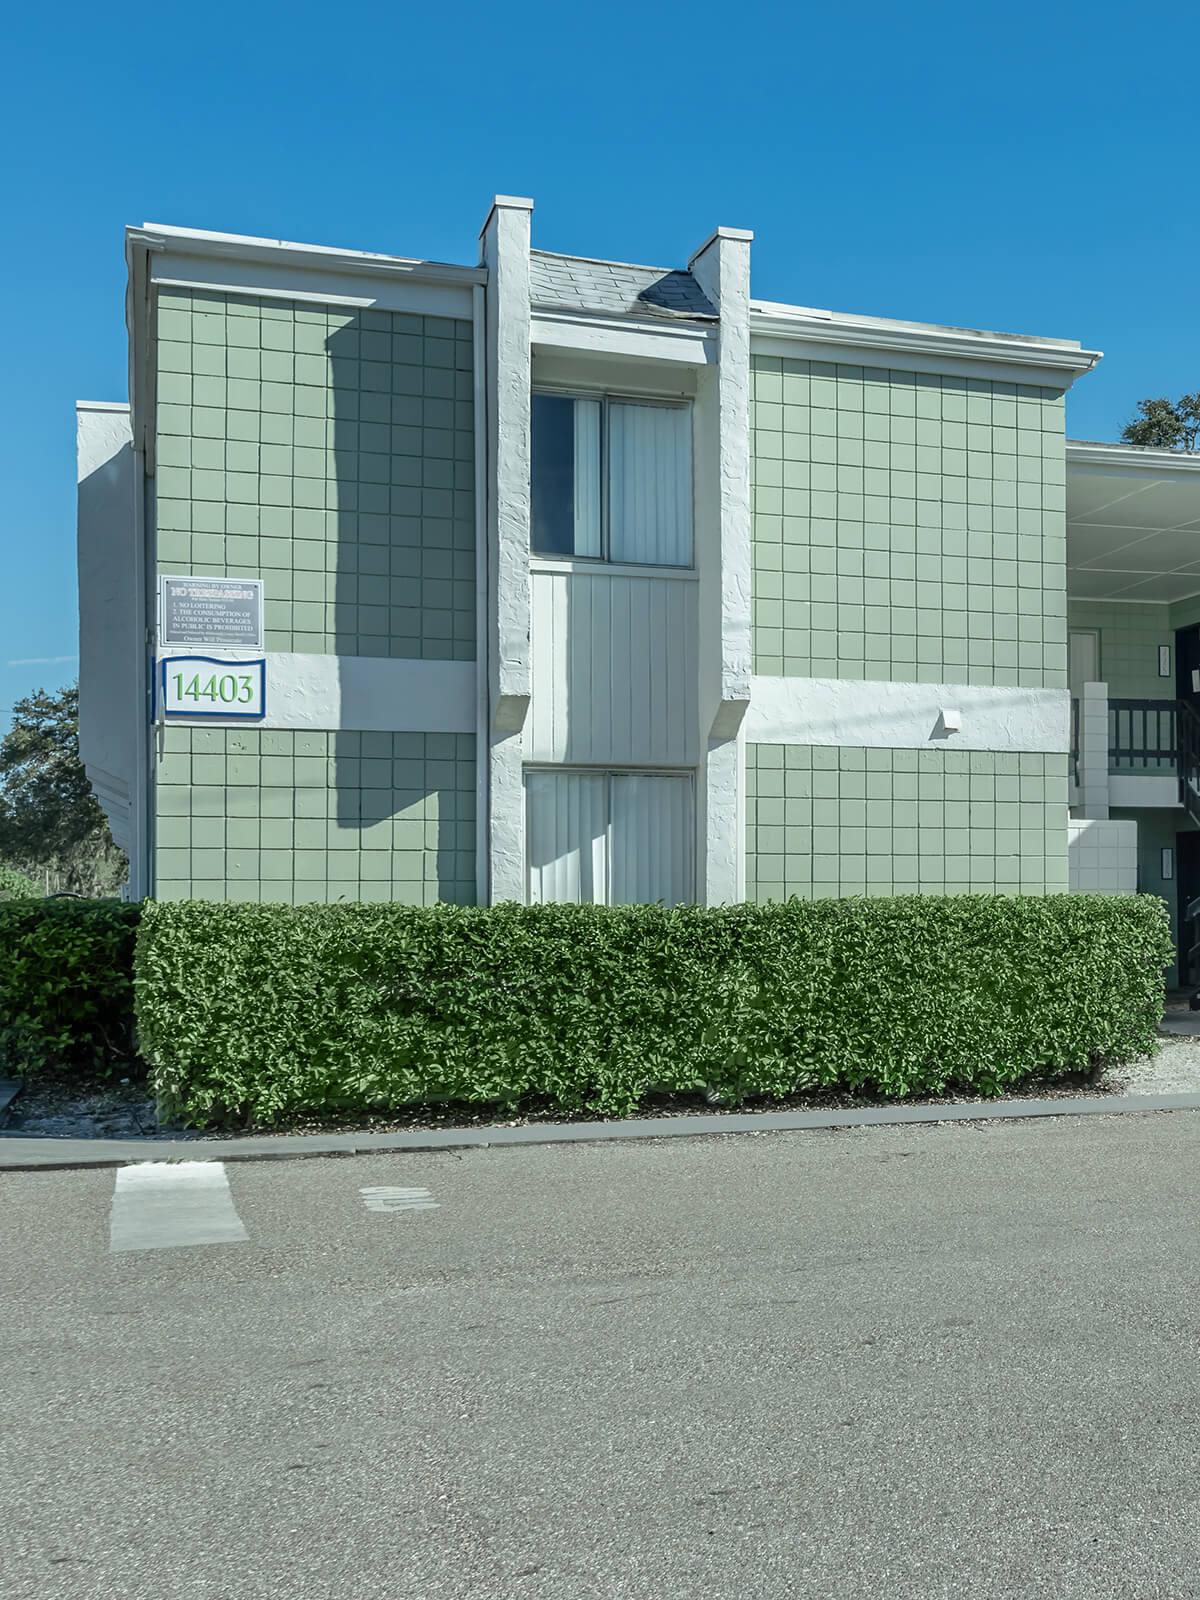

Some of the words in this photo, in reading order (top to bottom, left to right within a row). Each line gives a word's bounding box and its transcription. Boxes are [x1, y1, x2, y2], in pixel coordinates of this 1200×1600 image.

[170, 587, 187, 596] NO
[188, 588, 254, 599] TRESPASSING
[172, 672, 254, 703] 14403
